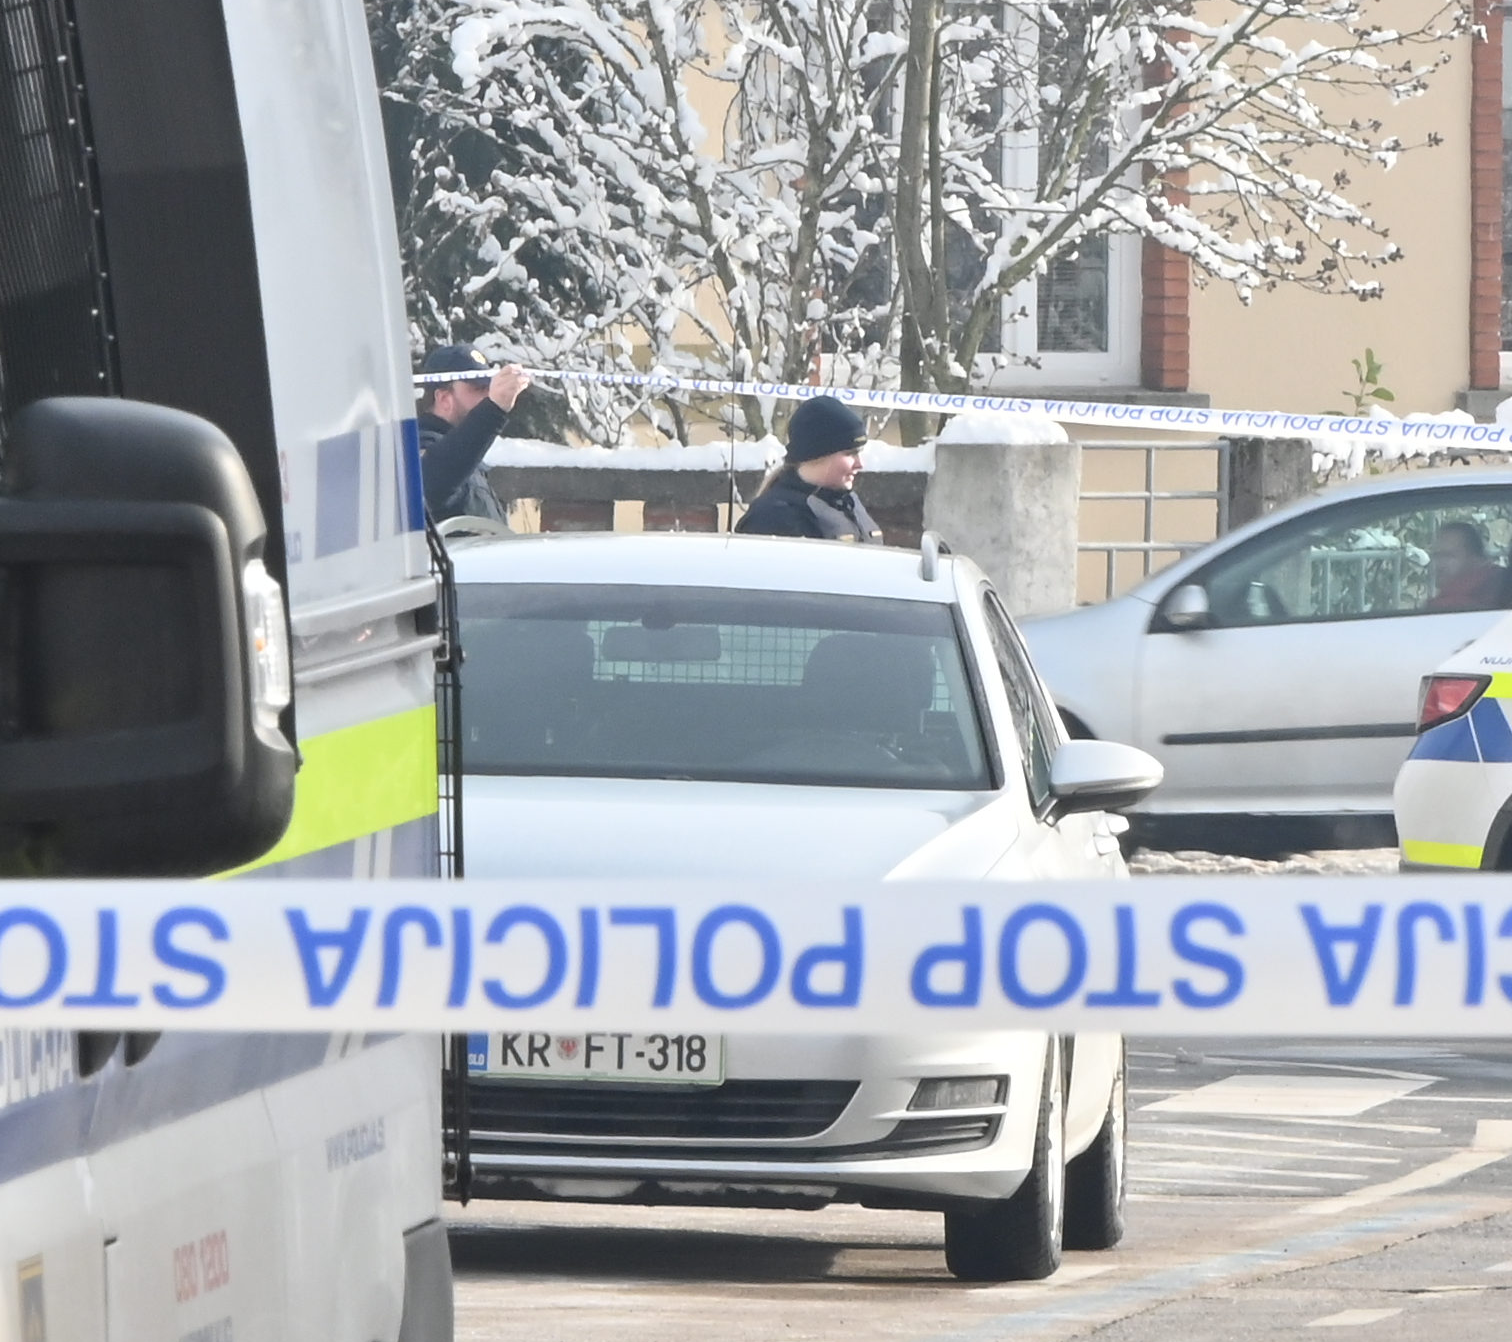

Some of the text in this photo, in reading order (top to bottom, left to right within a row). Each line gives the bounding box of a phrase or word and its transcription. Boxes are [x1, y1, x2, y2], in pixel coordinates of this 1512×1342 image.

[1222, 413, 1325, 430] POLICIJA
[1328, 418, 1393, 435] STOP
[1401, 422, 1505, 442] POLICIJA
[285, 903, 866, 1010] POLICIJA
[911, 901, 1247, 1010] STOP
[501, 1032, 707, 1073] KR FT-318
